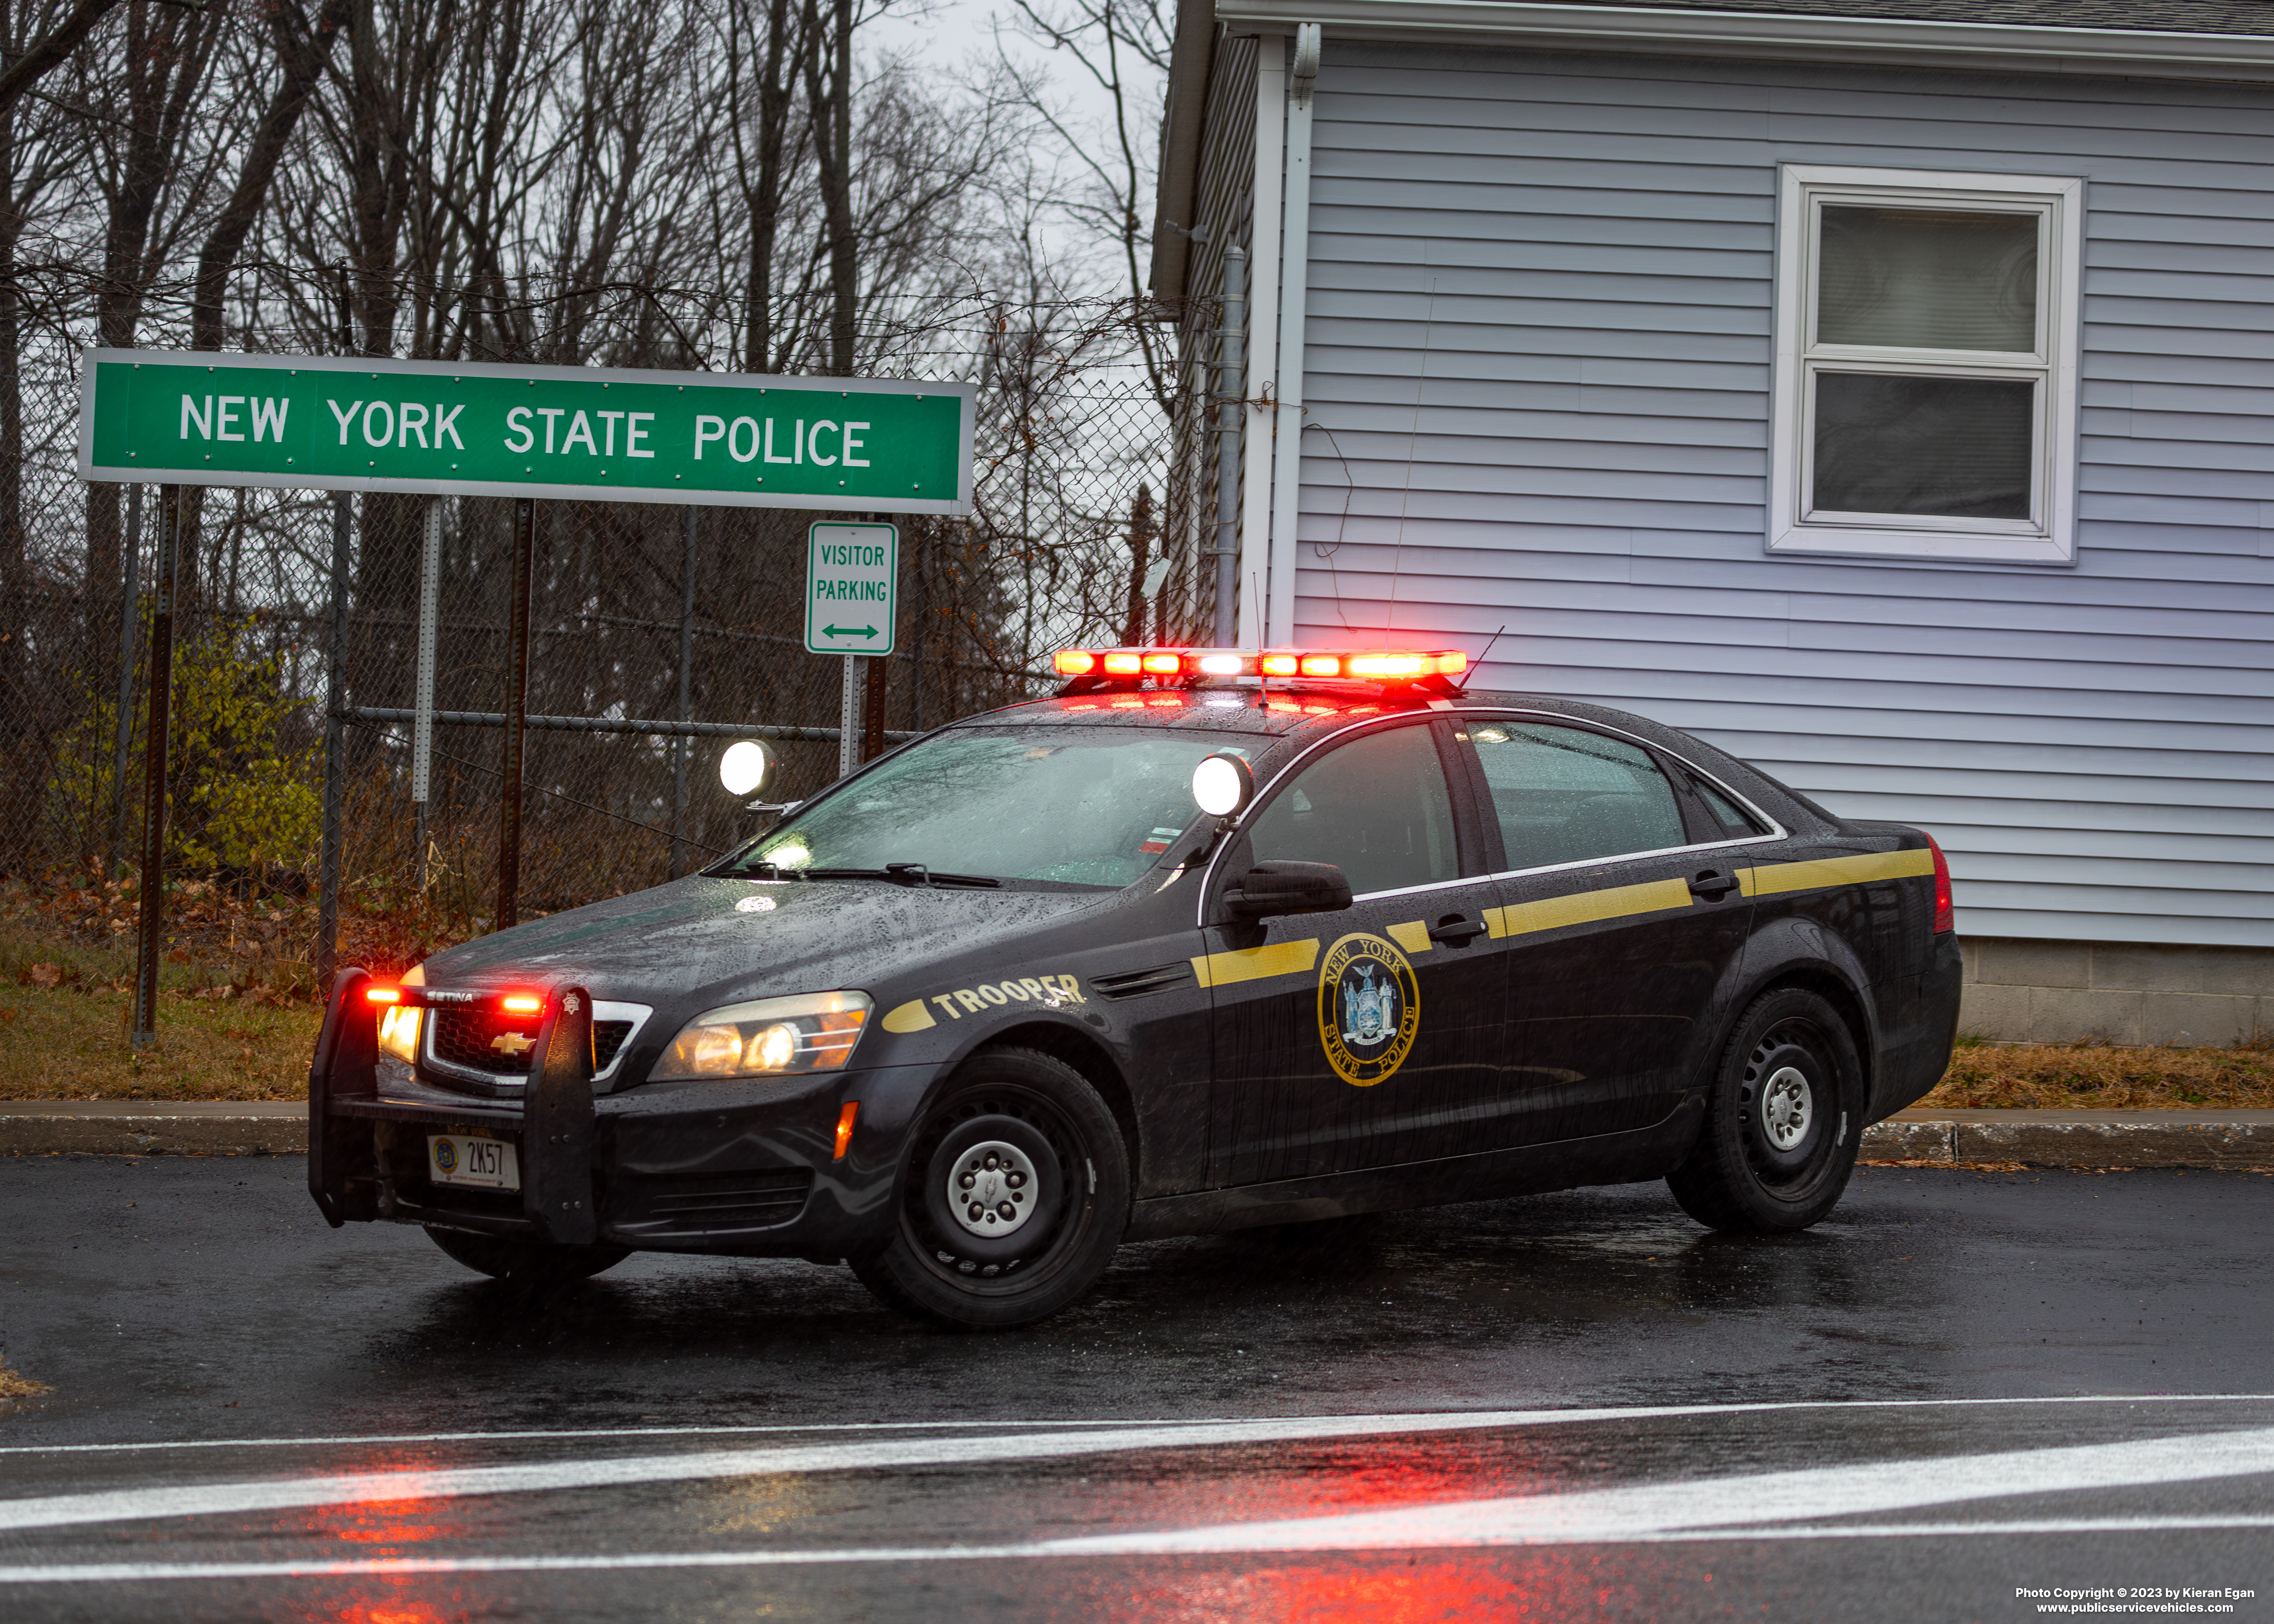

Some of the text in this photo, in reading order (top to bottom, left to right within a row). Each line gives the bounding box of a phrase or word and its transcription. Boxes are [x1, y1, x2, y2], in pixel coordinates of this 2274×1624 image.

[180, 394, 871, 467] NEW YORK STATE POLICE
[821, 545, 884, 566] VISITOR
[816, 580, 887, 602] PARKING
[1325, 939, 1404, 987] NEW YORK
[426, 991, 473, 1003] SETINA
[931, 974, 1086, 1020] TROOPER
[1324, 1006, 1415, 1078] STATE POLICE
[447, 1124, 469, 1135] NEW
[468, 1141, 503, 1175] 2K57
